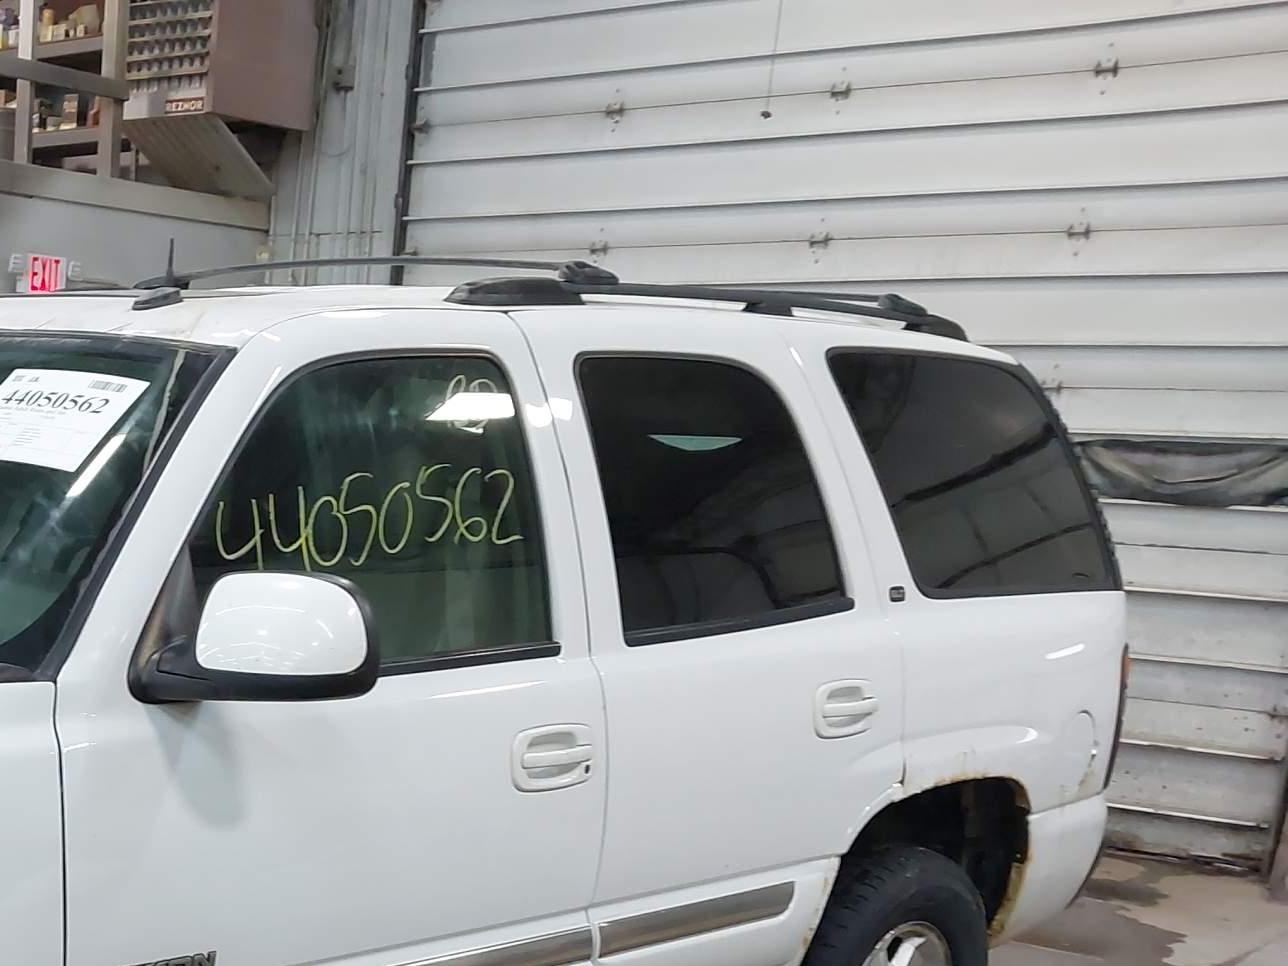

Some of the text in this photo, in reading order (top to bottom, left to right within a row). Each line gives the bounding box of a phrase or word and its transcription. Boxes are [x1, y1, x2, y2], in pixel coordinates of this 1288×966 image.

[30, 256, 61, 291] EXIT
[1, 388, 111, 415] 44050562
[215, 463, 525, 573] 44050562
